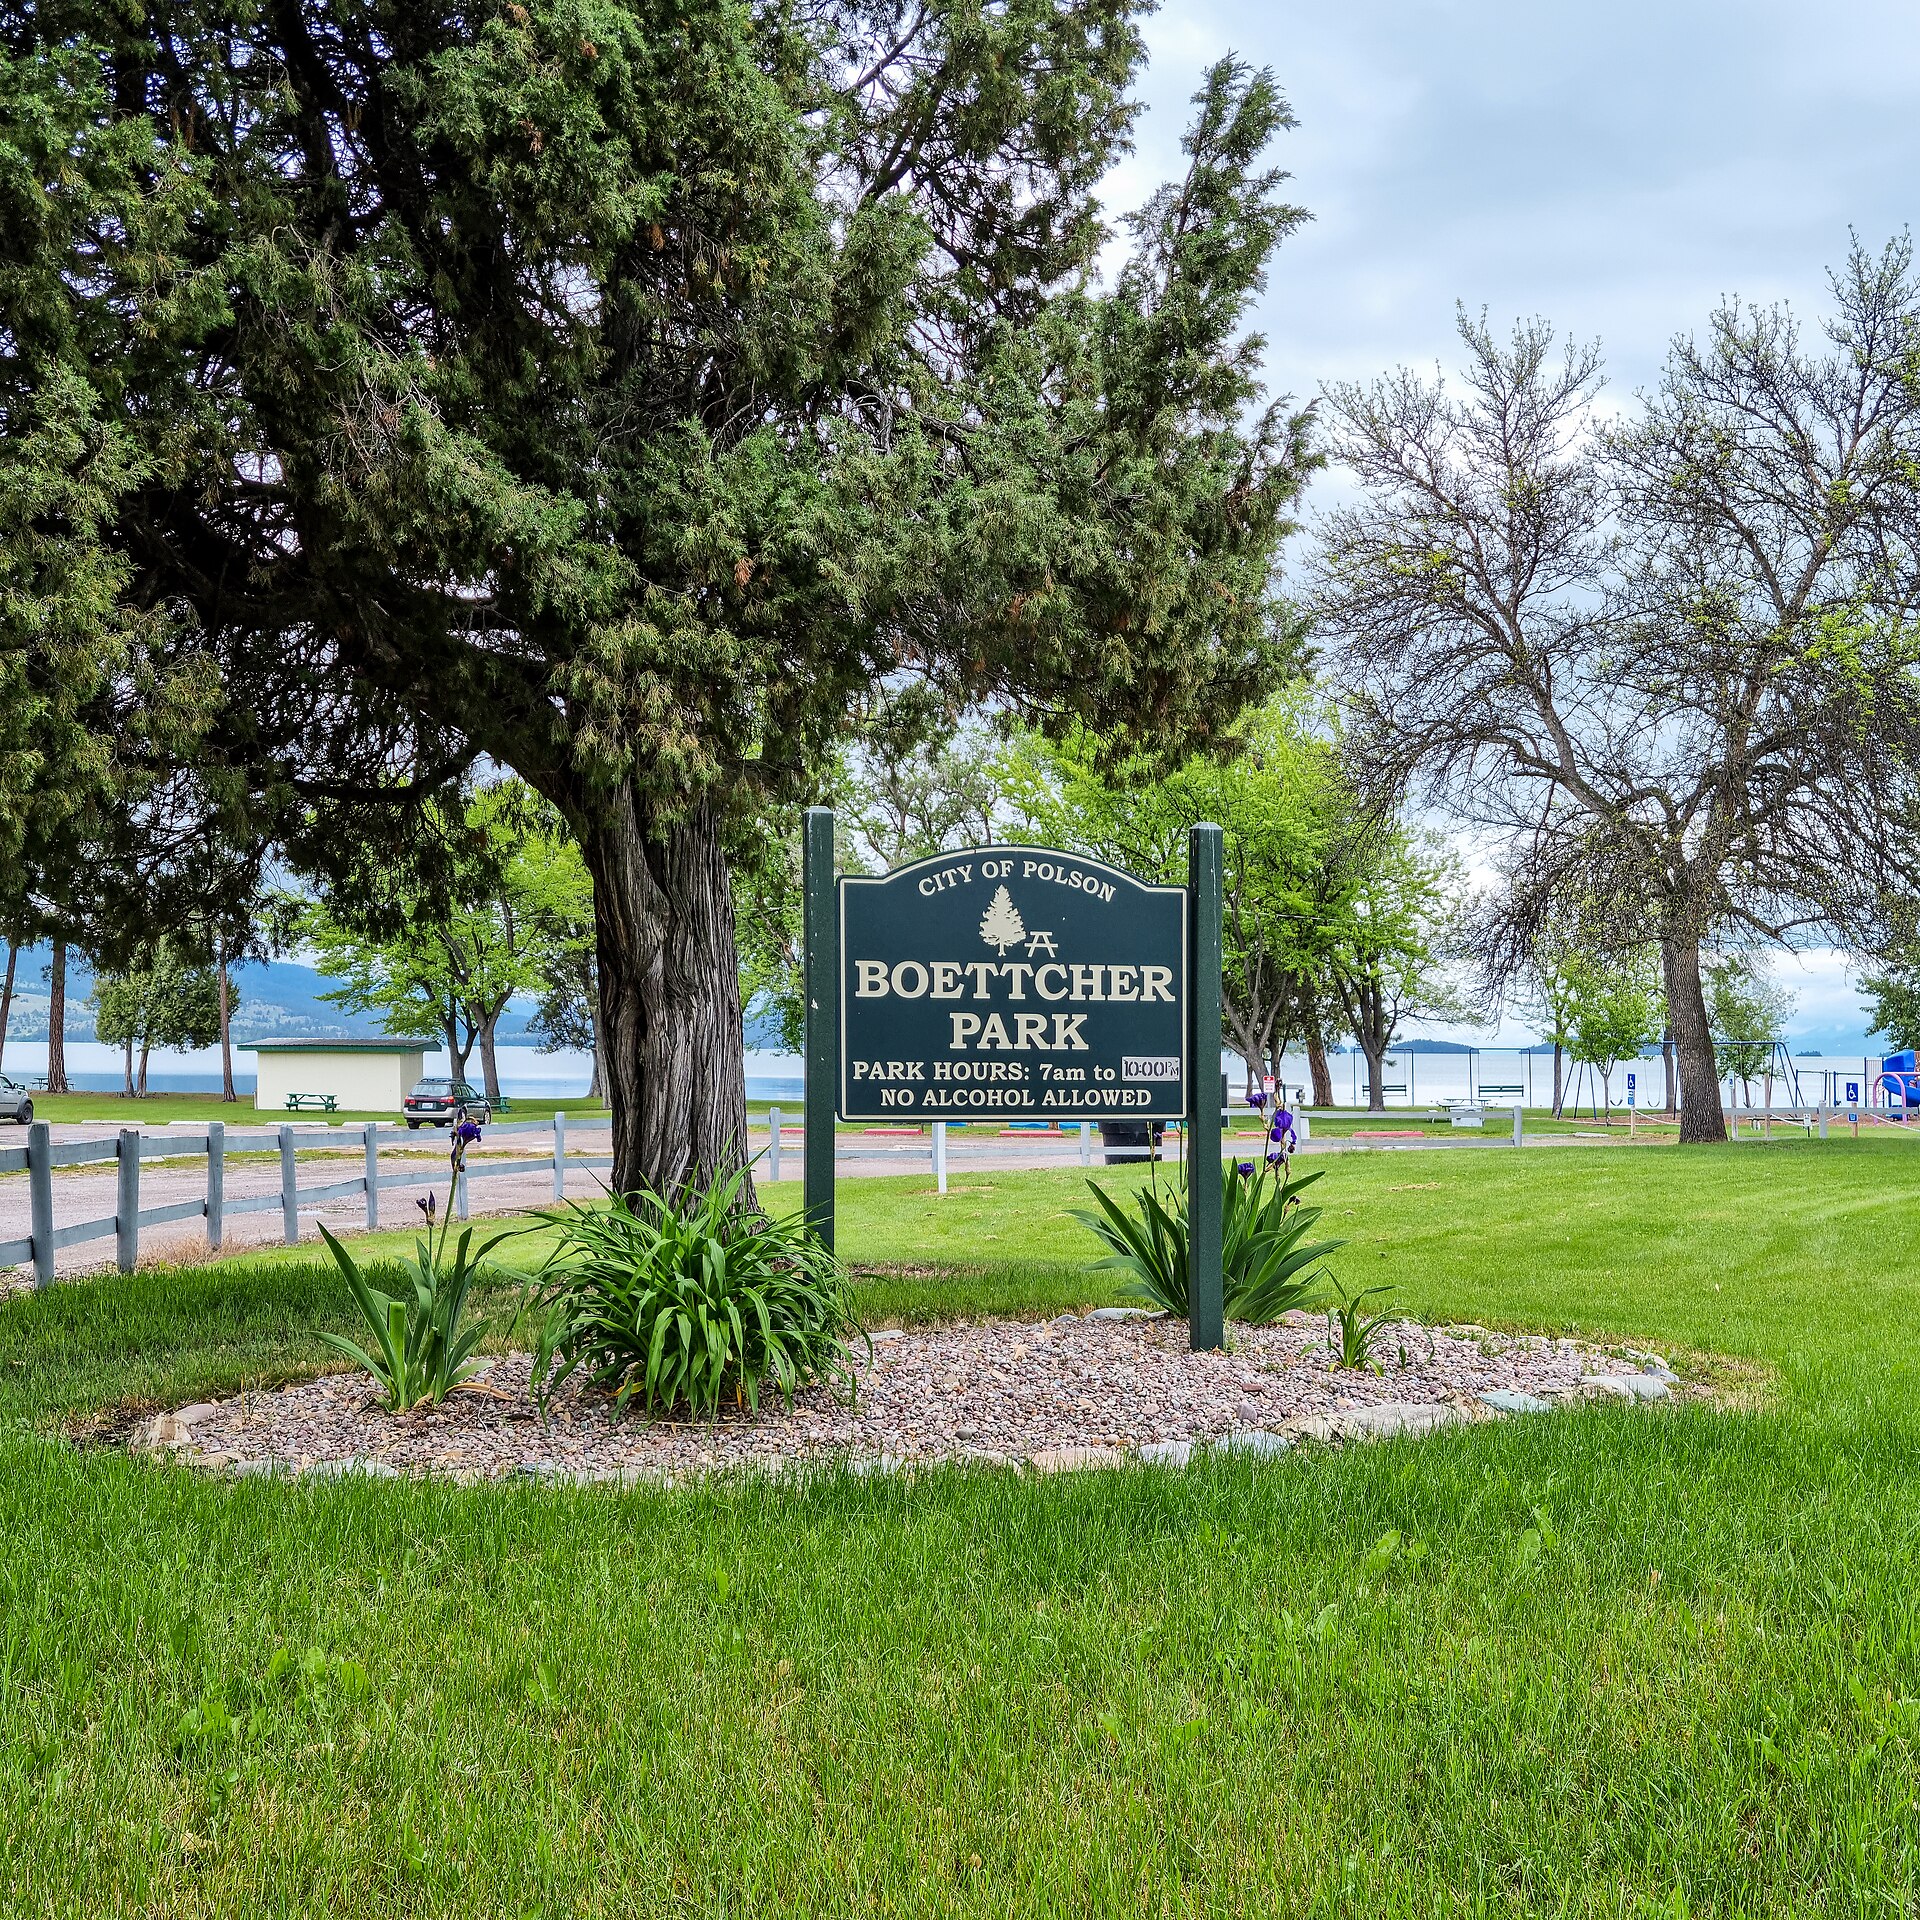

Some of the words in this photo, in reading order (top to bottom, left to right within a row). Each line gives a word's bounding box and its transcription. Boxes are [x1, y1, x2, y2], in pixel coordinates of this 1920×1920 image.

[918, 864, 973, 896] CITY
[981, 860, 1014, 879] OF
[1023, 860, 1117, 902] POLSON
[855, 960, 1176, 1002] BOETTCHER
[949, 1012, 1090, 1050] PARK
[852, 1061, 924, 1080] PARK
[933, 1062, 1030, 1081] HOURS:
[1039, 1063, 1086, 1081] 7am
[1093, 1065, 1116, 1080] to
[880, 1089, 915, 1106] NO
[922, 1089, 1035, 1106] ALCOHOL
[1042, 1089, 1152, 1106] ALLOWED
